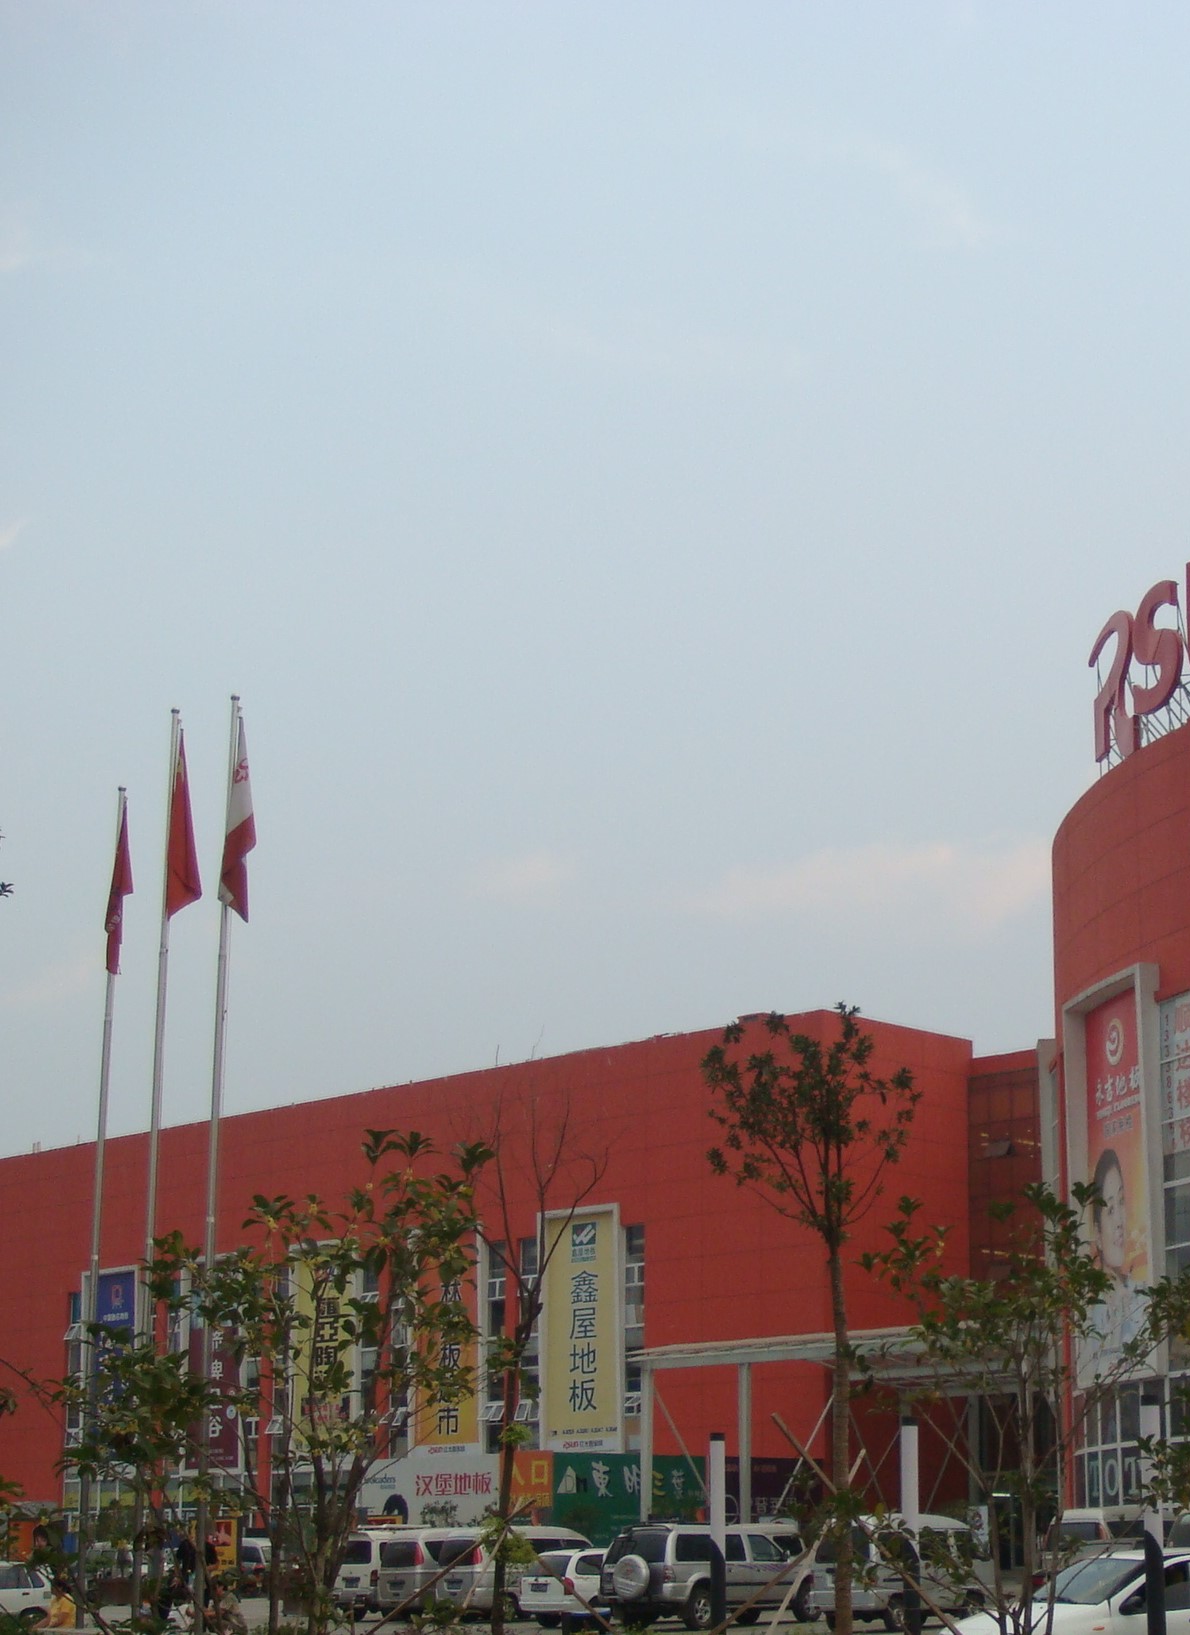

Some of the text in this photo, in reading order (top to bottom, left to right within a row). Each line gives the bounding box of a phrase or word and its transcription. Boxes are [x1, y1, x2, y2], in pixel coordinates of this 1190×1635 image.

[568, 1269, 599, 1413] 鑫屋地板
[415, 1471, 493, 1497] 汉堡地板
